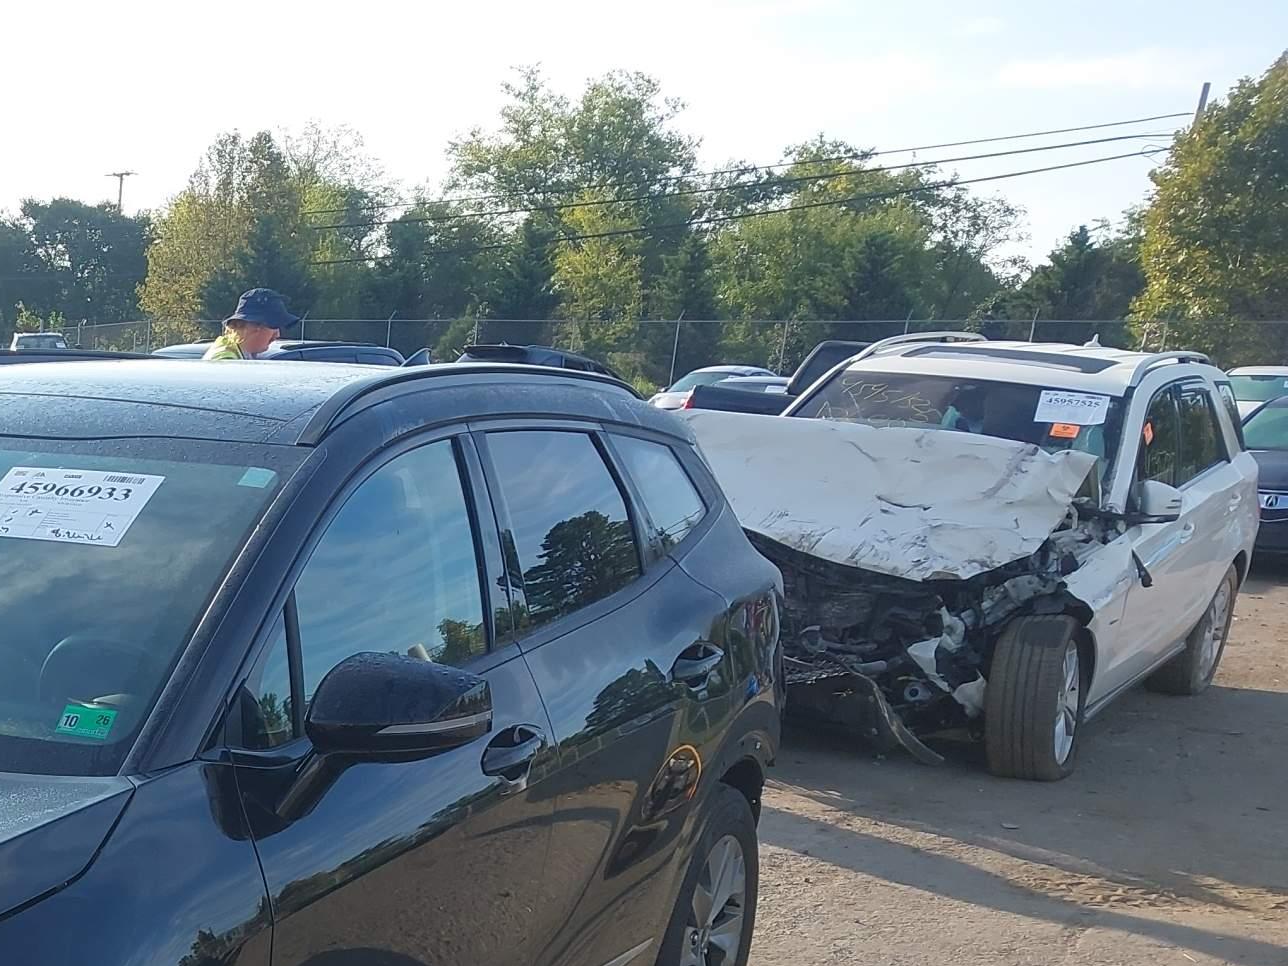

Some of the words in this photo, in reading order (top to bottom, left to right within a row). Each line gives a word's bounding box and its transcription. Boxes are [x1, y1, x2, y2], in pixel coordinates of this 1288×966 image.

[1046, 397, 1102, 409] 45957525
[9, 480, 133, 502] 45966933
[63, 714, 80, 728] 10
[95, 714, 111, 726] 26
